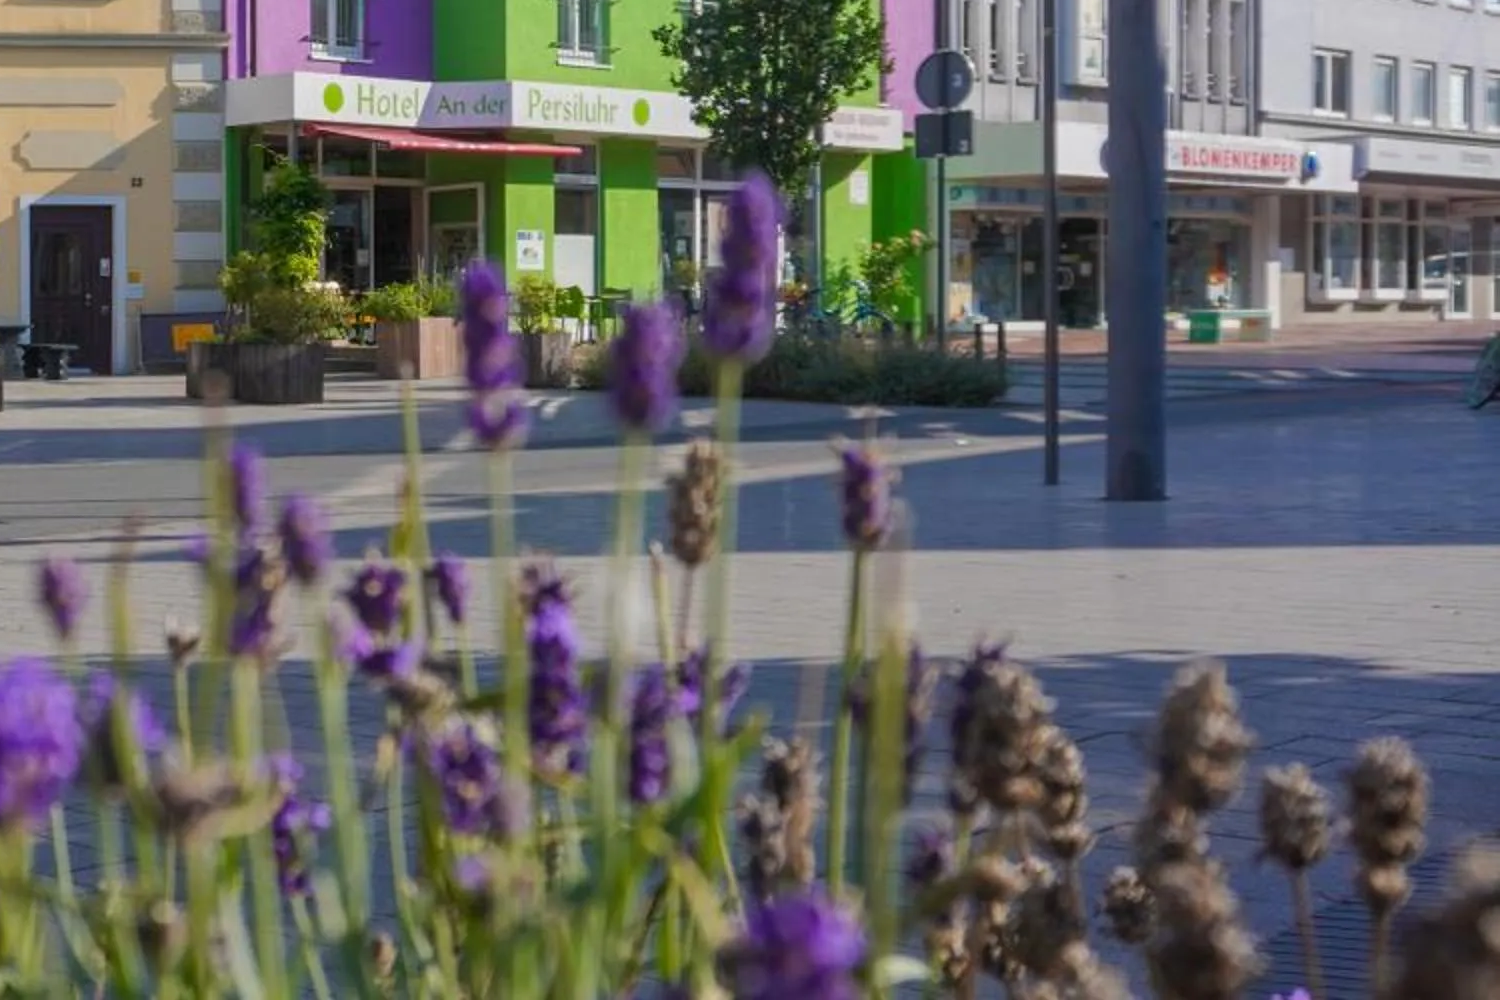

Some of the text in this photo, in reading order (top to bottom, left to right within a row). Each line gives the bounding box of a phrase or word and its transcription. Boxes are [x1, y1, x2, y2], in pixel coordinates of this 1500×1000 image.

[357, 82, 619, 125] Hotel An der Persiluhr
